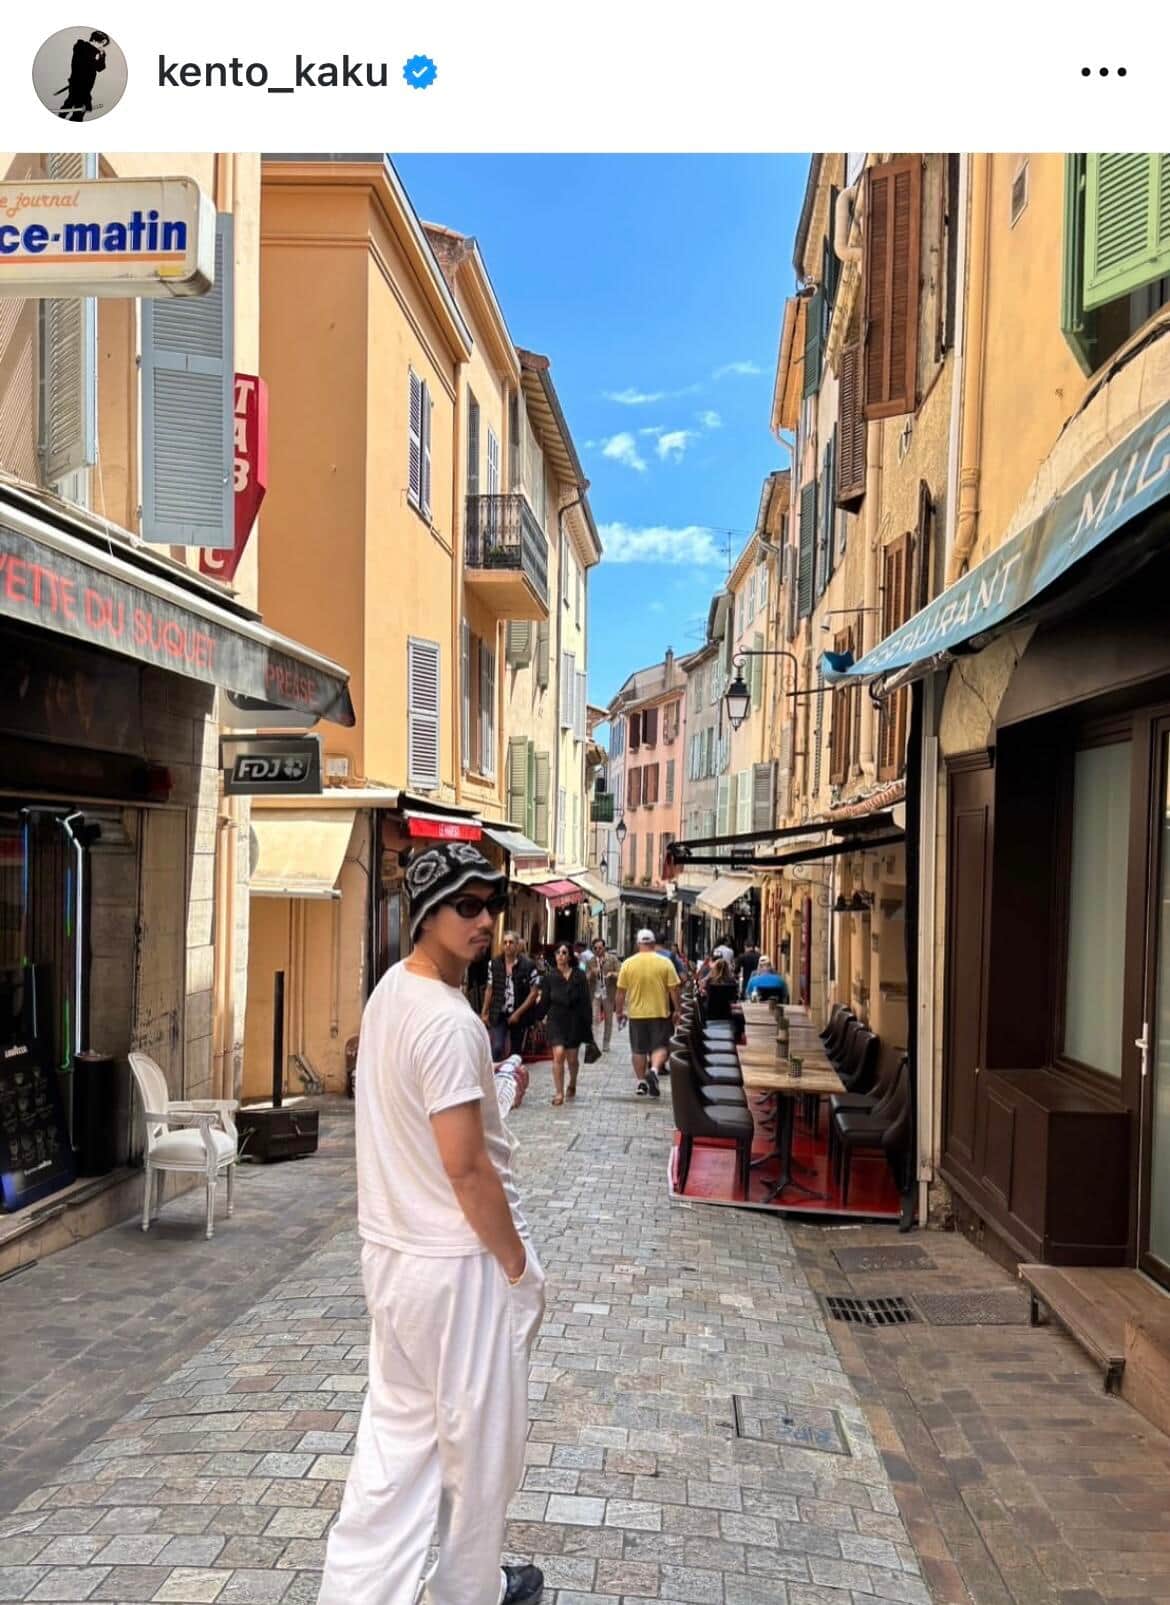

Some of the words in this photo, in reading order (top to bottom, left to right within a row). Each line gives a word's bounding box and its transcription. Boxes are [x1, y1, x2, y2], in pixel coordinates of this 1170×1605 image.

[5, 189, 81, 218] journal
[0, 553, 77, 622] ETTE
[83, 586, 125, 638] DU
[133, 607, 216, 673] SUQUET
[238, 759, 281, 778] FDJ
